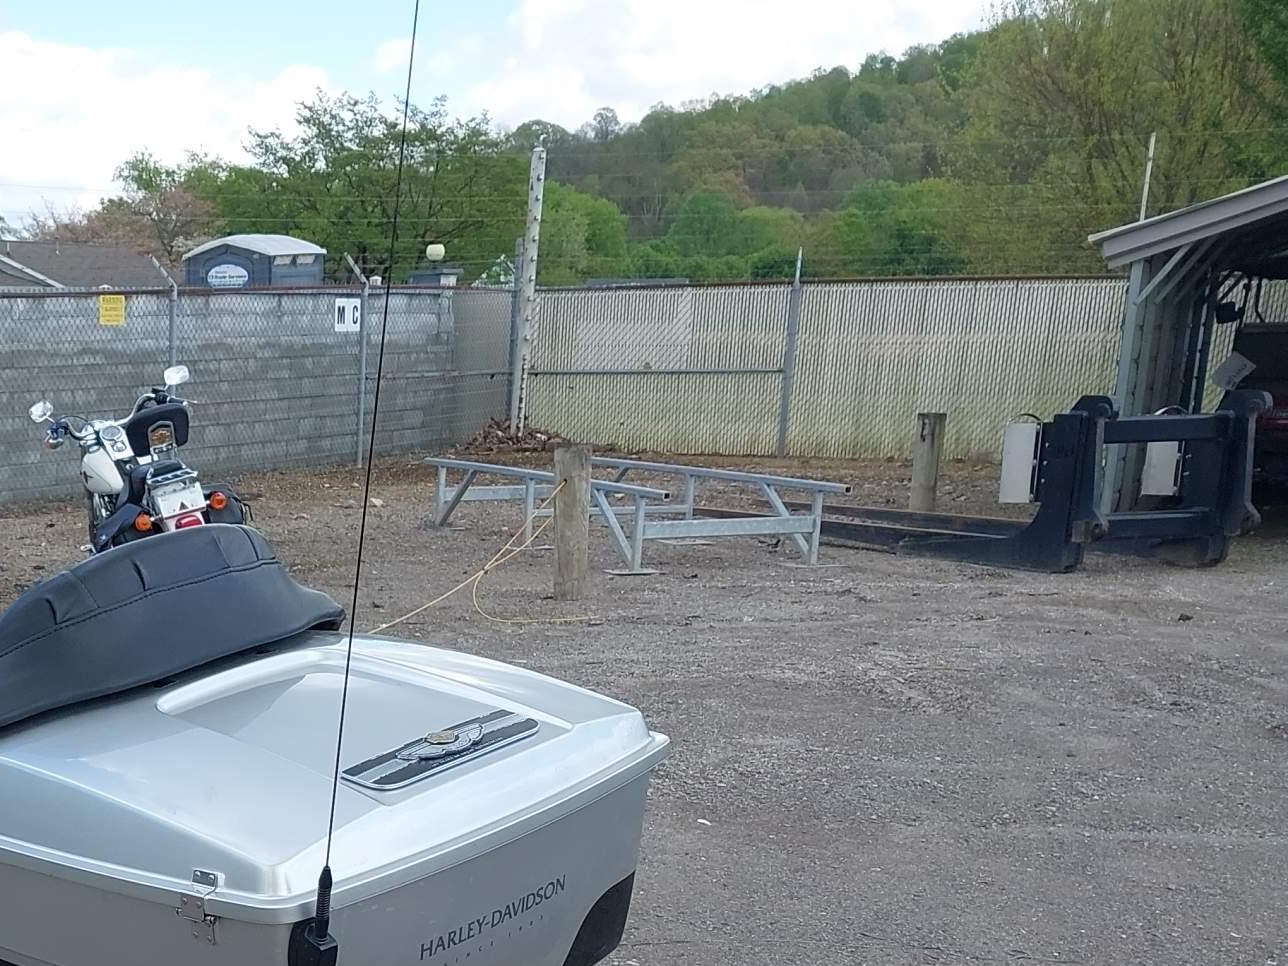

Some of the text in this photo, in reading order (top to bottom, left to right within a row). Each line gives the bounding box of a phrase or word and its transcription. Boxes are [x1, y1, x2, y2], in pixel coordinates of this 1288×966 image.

[337, 305, 359, 325] M C
[420, 874, 566, 961] HARLEY-DAVIDSON
